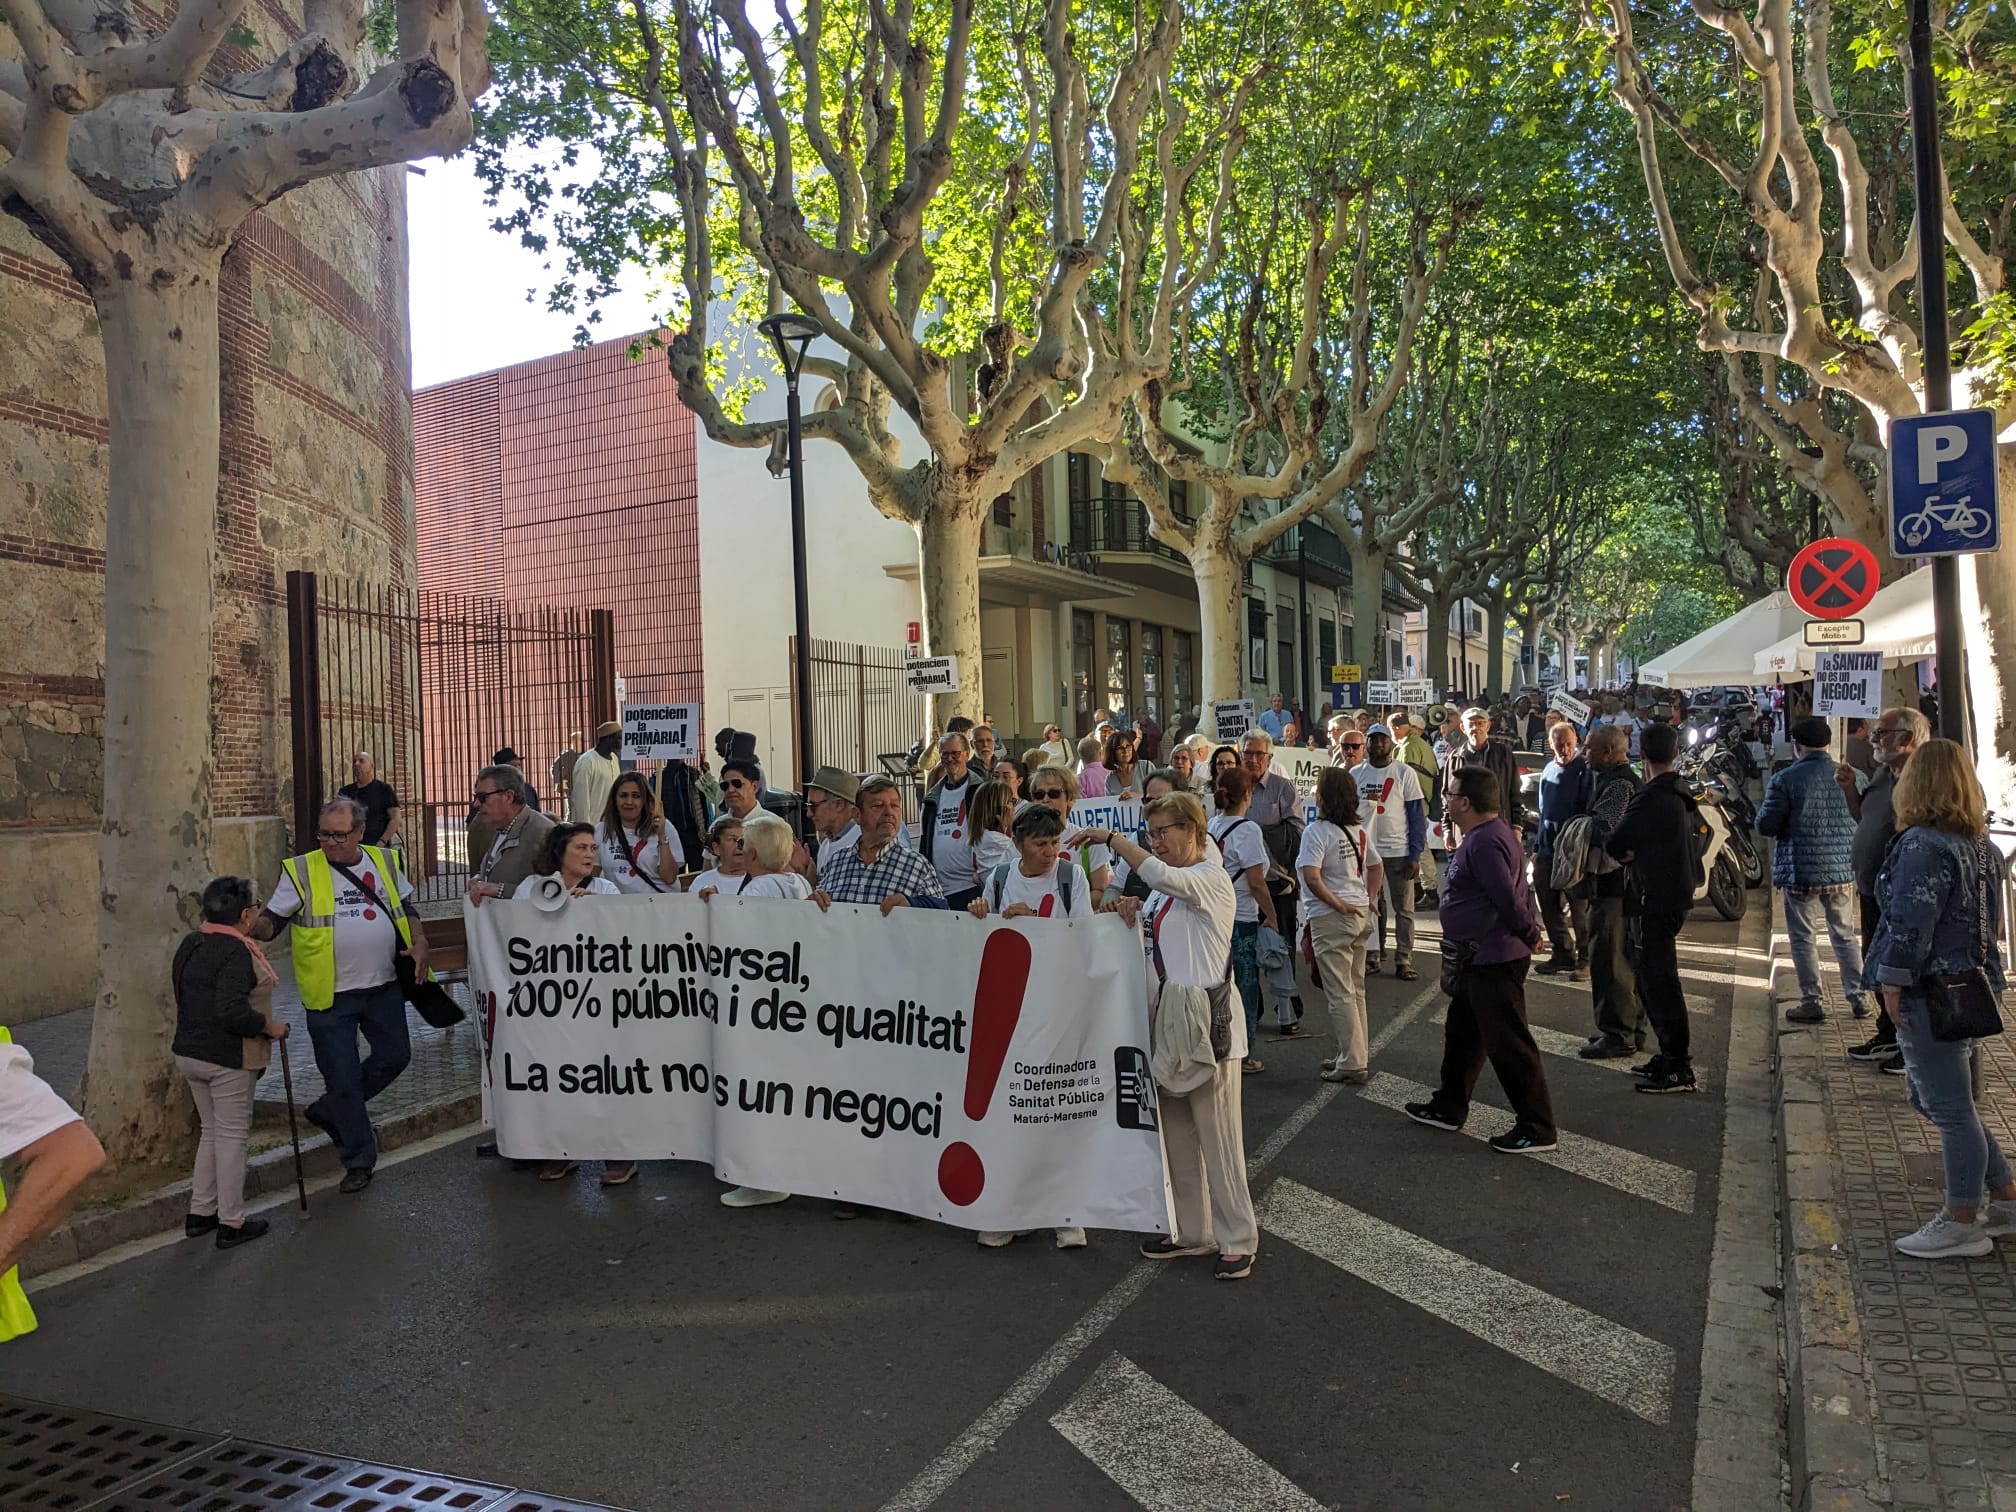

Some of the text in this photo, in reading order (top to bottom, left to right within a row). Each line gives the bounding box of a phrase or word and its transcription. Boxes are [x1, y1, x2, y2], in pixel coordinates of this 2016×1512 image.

[1917, 425, 1968, 484] P
[1817, 624, 1850, 632] Excepte
[907, 659, 949, 671] potenciem
[1833, 653, 1880, 671] SANITAT
[1817, 671, 1827, 683] no
[1839, 671, 1850, 683] un
[625, 706, 688, 722] potenciem
[1217, 715, 1243, 727] SANITAT
[637, 721, 647, 731] la
[507, 932, 810, 992] Sanitat universal,
[506, 977, 601, 1019] 100%
[728, 984, 740, 1027] i
[751, 987, 807, 1033] de
[817, 999, 966, 1053] qualitat
[1015, 1059, 1096, 1075] Coordinadora
[1010, 1076, 1100, 1091] en Defensa de la
[504, 1052, 548, 1092] La
[558, 1054, 653, 1095] salut
[662, 1063, 710, 1094] no
[739, 1078, 794, 1116] un
[805, 1085, 942, 1139] negoci
[1009, 1091, 1105, 1108] Sanitat Pública
[1013, 1109, 1098, 1124] Mataró-Maresme
